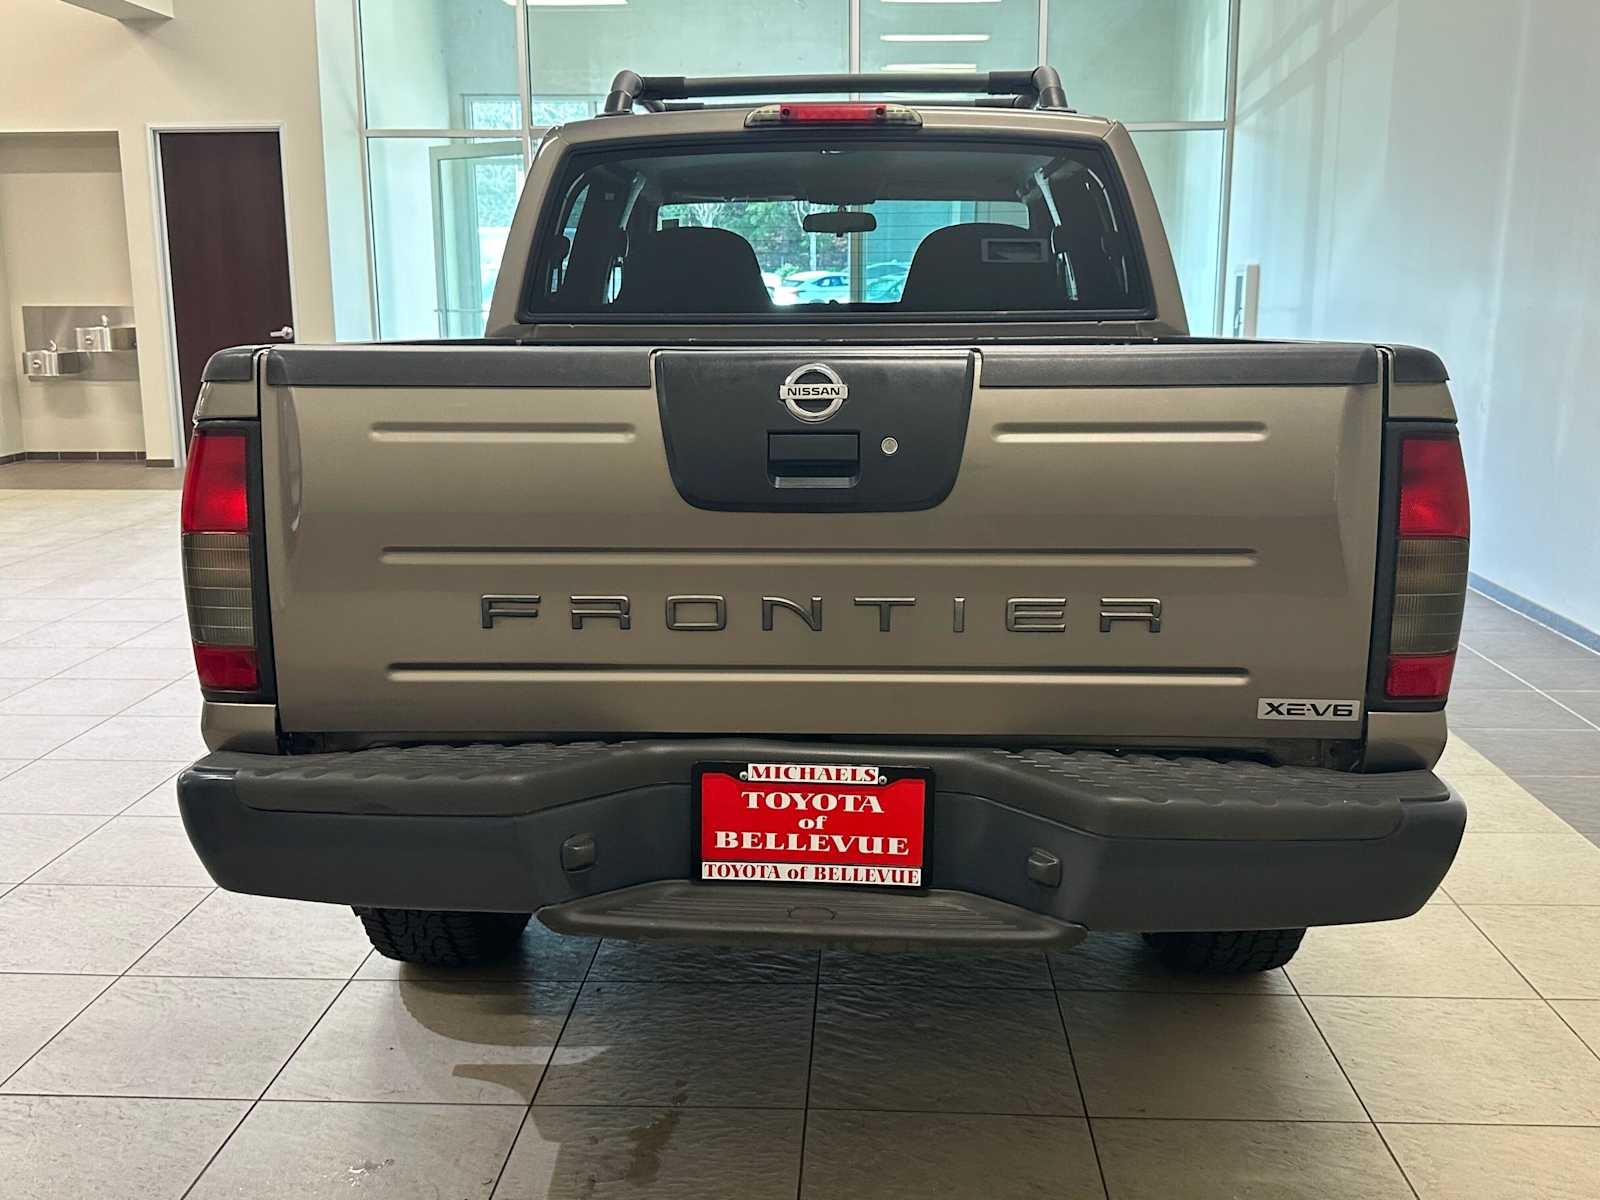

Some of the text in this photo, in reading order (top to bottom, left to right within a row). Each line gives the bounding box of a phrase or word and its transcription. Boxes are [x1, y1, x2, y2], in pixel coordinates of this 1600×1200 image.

[787, 387, 840, 396] NISSAN
[481, 594, 1161, 633] FRONTIER
[1264, 702, 1353, 716] XE-V6
[751, 765, 876, 782] MICHAELS
[741, 791, 884, 813] TOYOTA
[798, 816, 827, 829] of
[715, 831, 909, 855] BELLEVUE
[704, 863, 919, 884] TOYOTA of BELLEVUE
